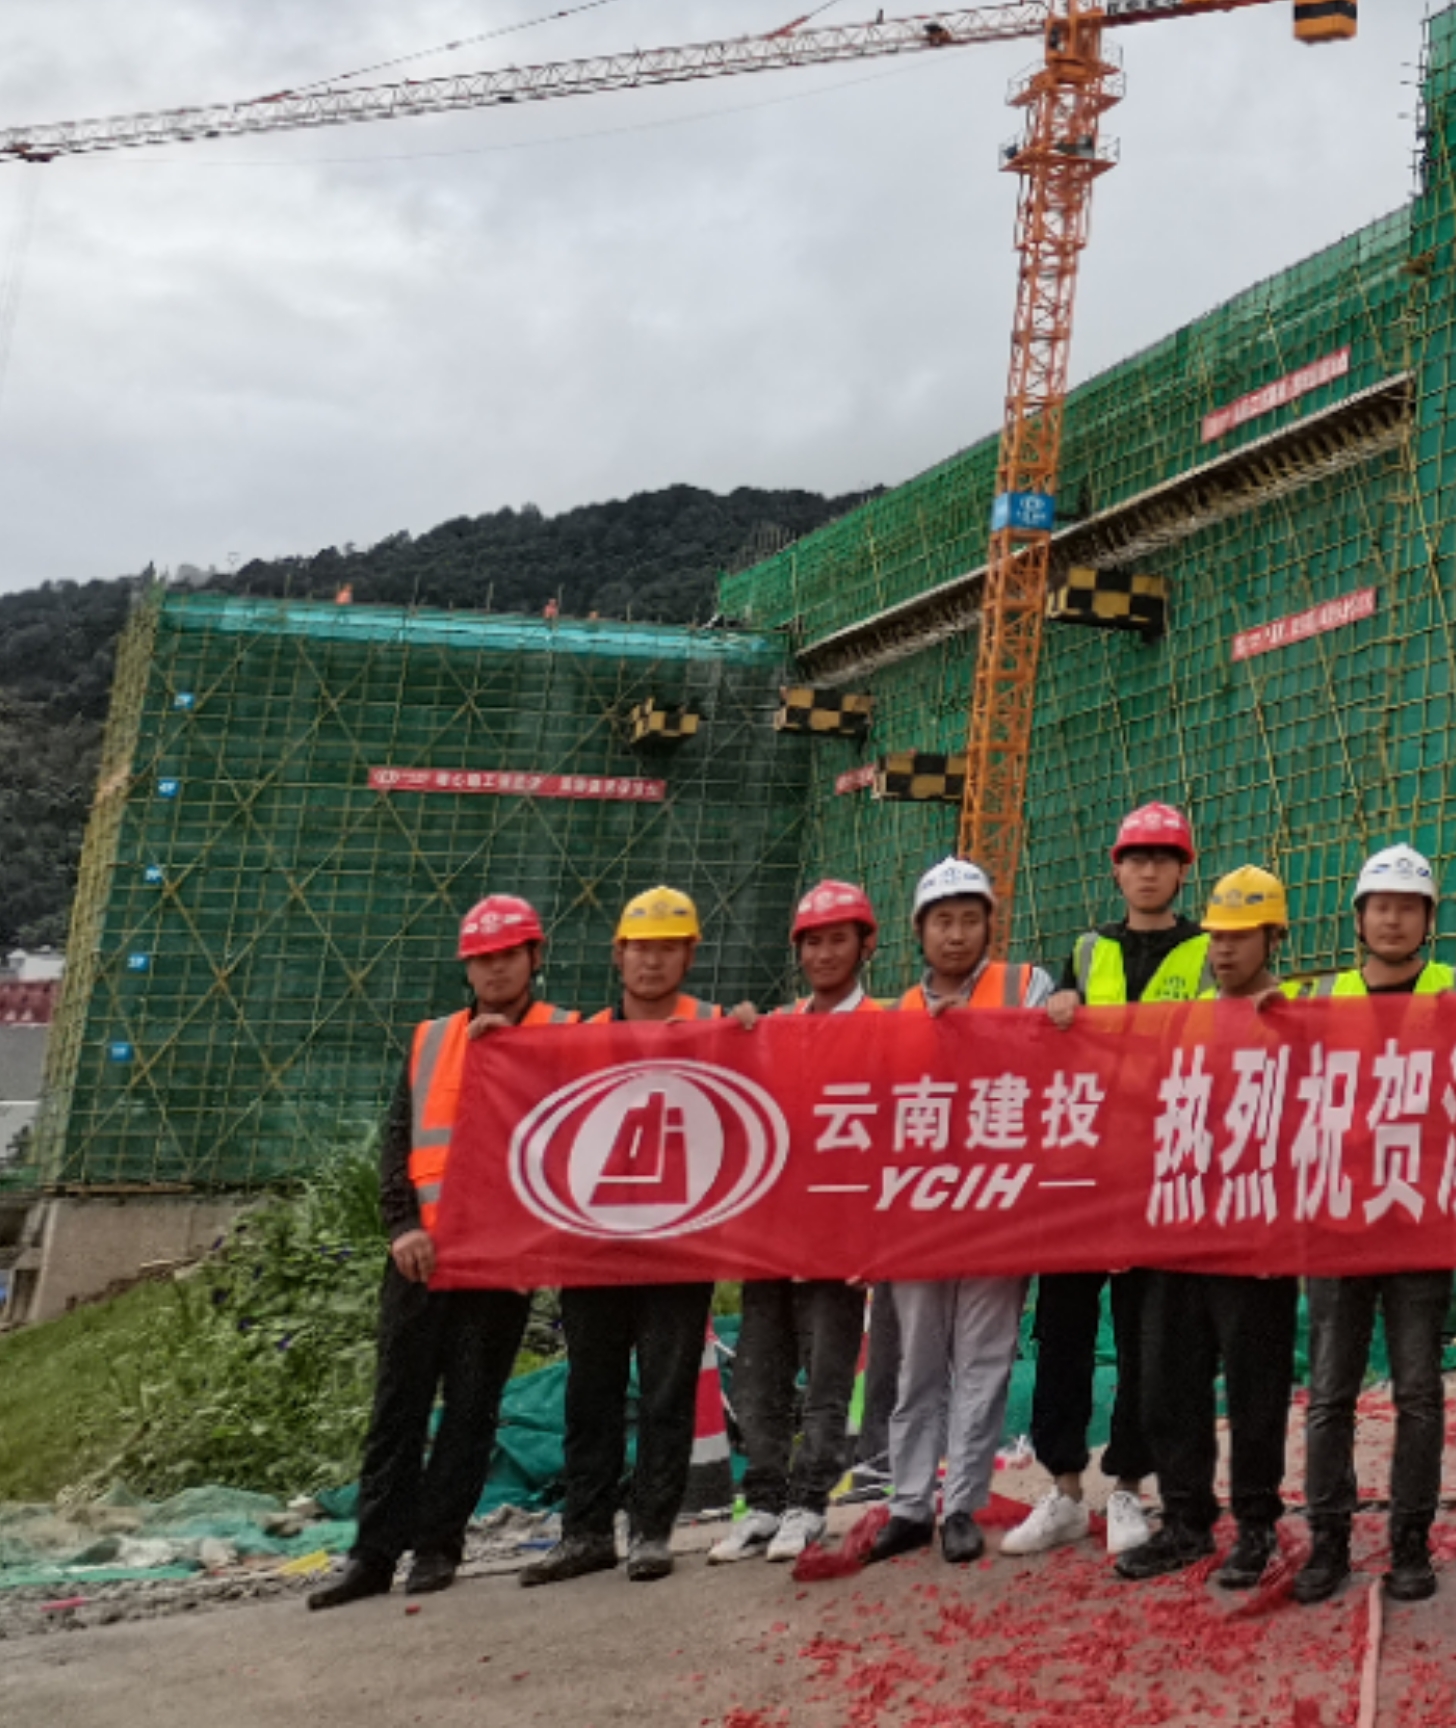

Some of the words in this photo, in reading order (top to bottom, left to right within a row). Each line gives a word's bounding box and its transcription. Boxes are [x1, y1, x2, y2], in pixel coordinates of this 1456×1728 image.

[811, 1070, 1106, 1152] 云南建投
[873, 1163, 1034, 1212] YCIH
